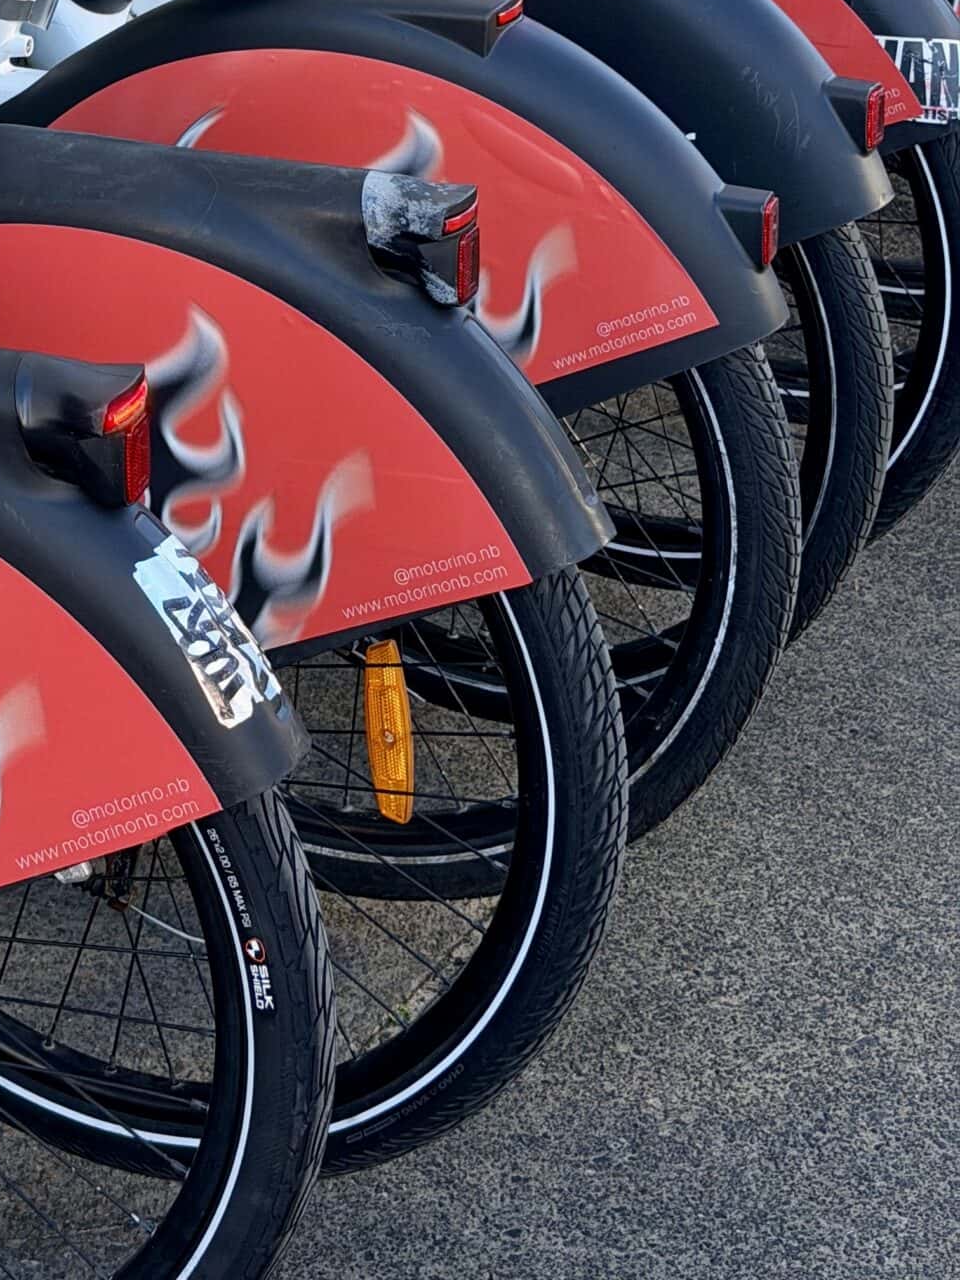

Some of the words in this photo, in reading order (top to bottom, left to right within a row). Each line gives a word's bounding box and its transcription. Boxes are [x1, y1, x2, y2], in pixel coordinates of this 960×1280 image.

[596, 294, 690, 337] @motorino.nb
[552, 310, 697, 370] www.motorinonb.com
[393, 544, 501, 586] @motorino.nb
[341, 565, 509, 619] www.motorinonb.com
[71, 777, 191, 829] @motorino.nb
[15, 799, 200, 870] www.motorinonb.com
[232, 888, 247, 913] MAX
[241, 911, 252, 929] PSI
[249, 963, 266, 1011] SHIELD
[258, 964, 275, 1011] SILK
